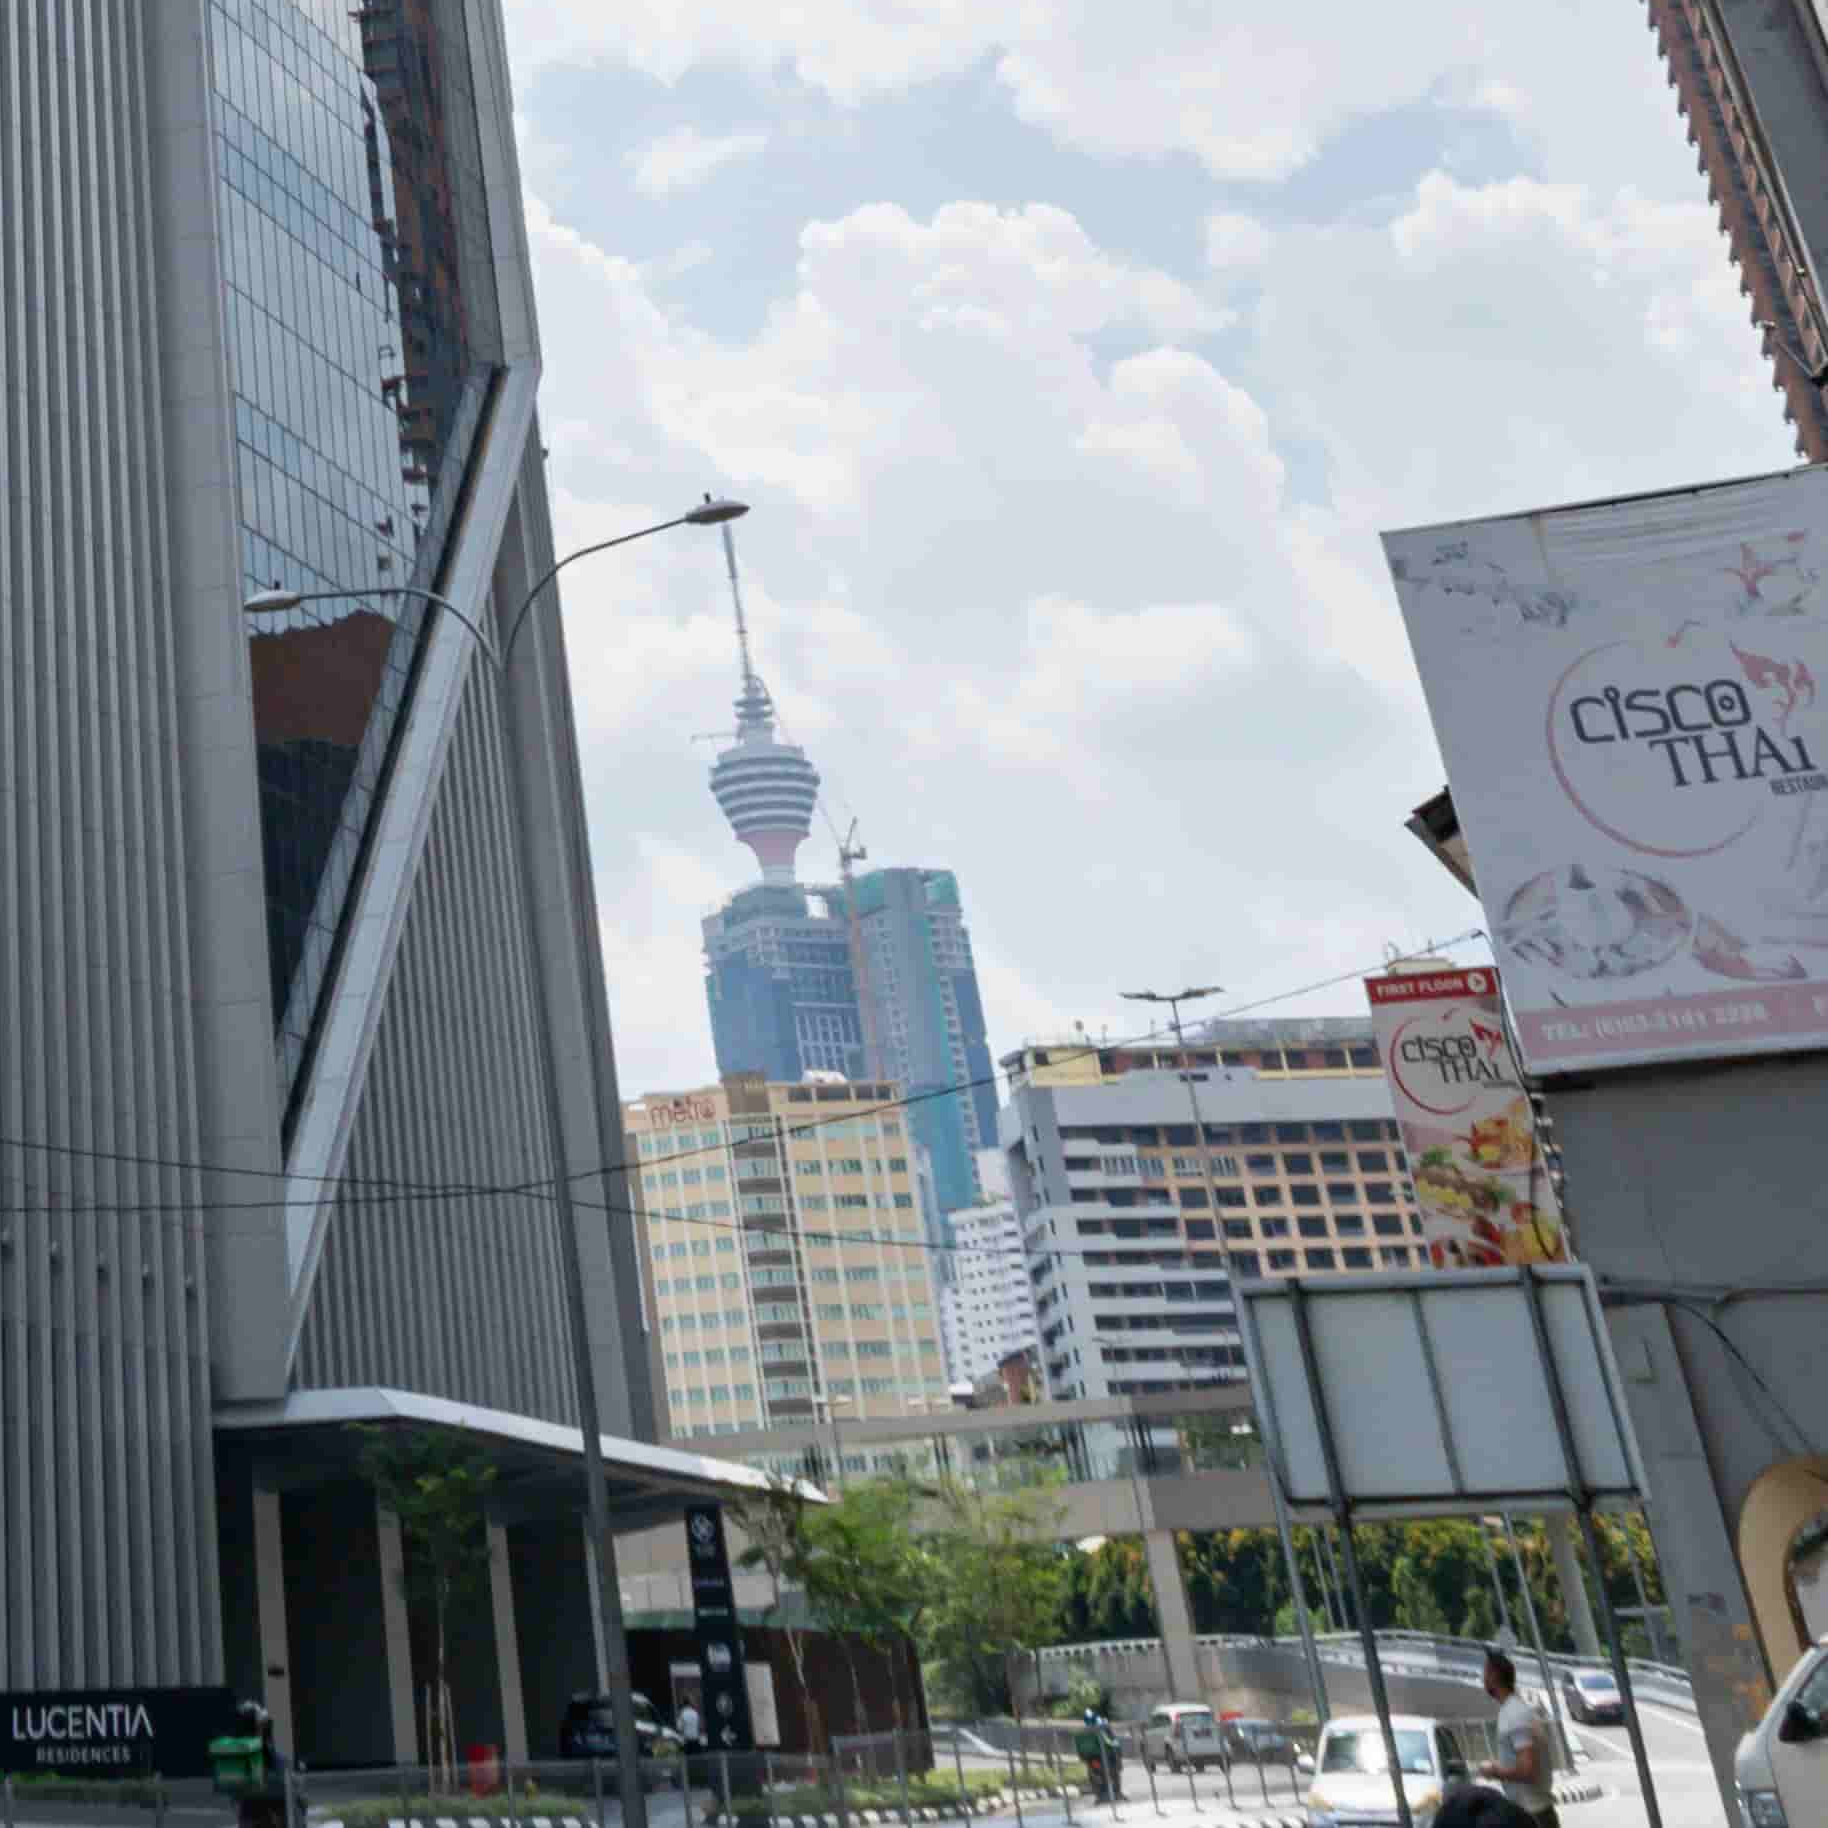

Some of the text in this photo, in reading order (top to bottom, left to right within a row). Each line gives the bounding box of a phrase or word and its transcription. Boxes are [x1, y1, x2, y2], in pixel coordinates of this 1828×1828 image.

[1570, 679, 1752, 744] CISCO
[1376, 977, 1465, 997] FIRST FLOOR
[1401, 1034, 1477, 1063] CISCO
[651, 1095, 716, 1126] metro
[11, 1703, 155, 1741] LUCENTIA
[35, 1744, 132, 1764] RESIDENCES
